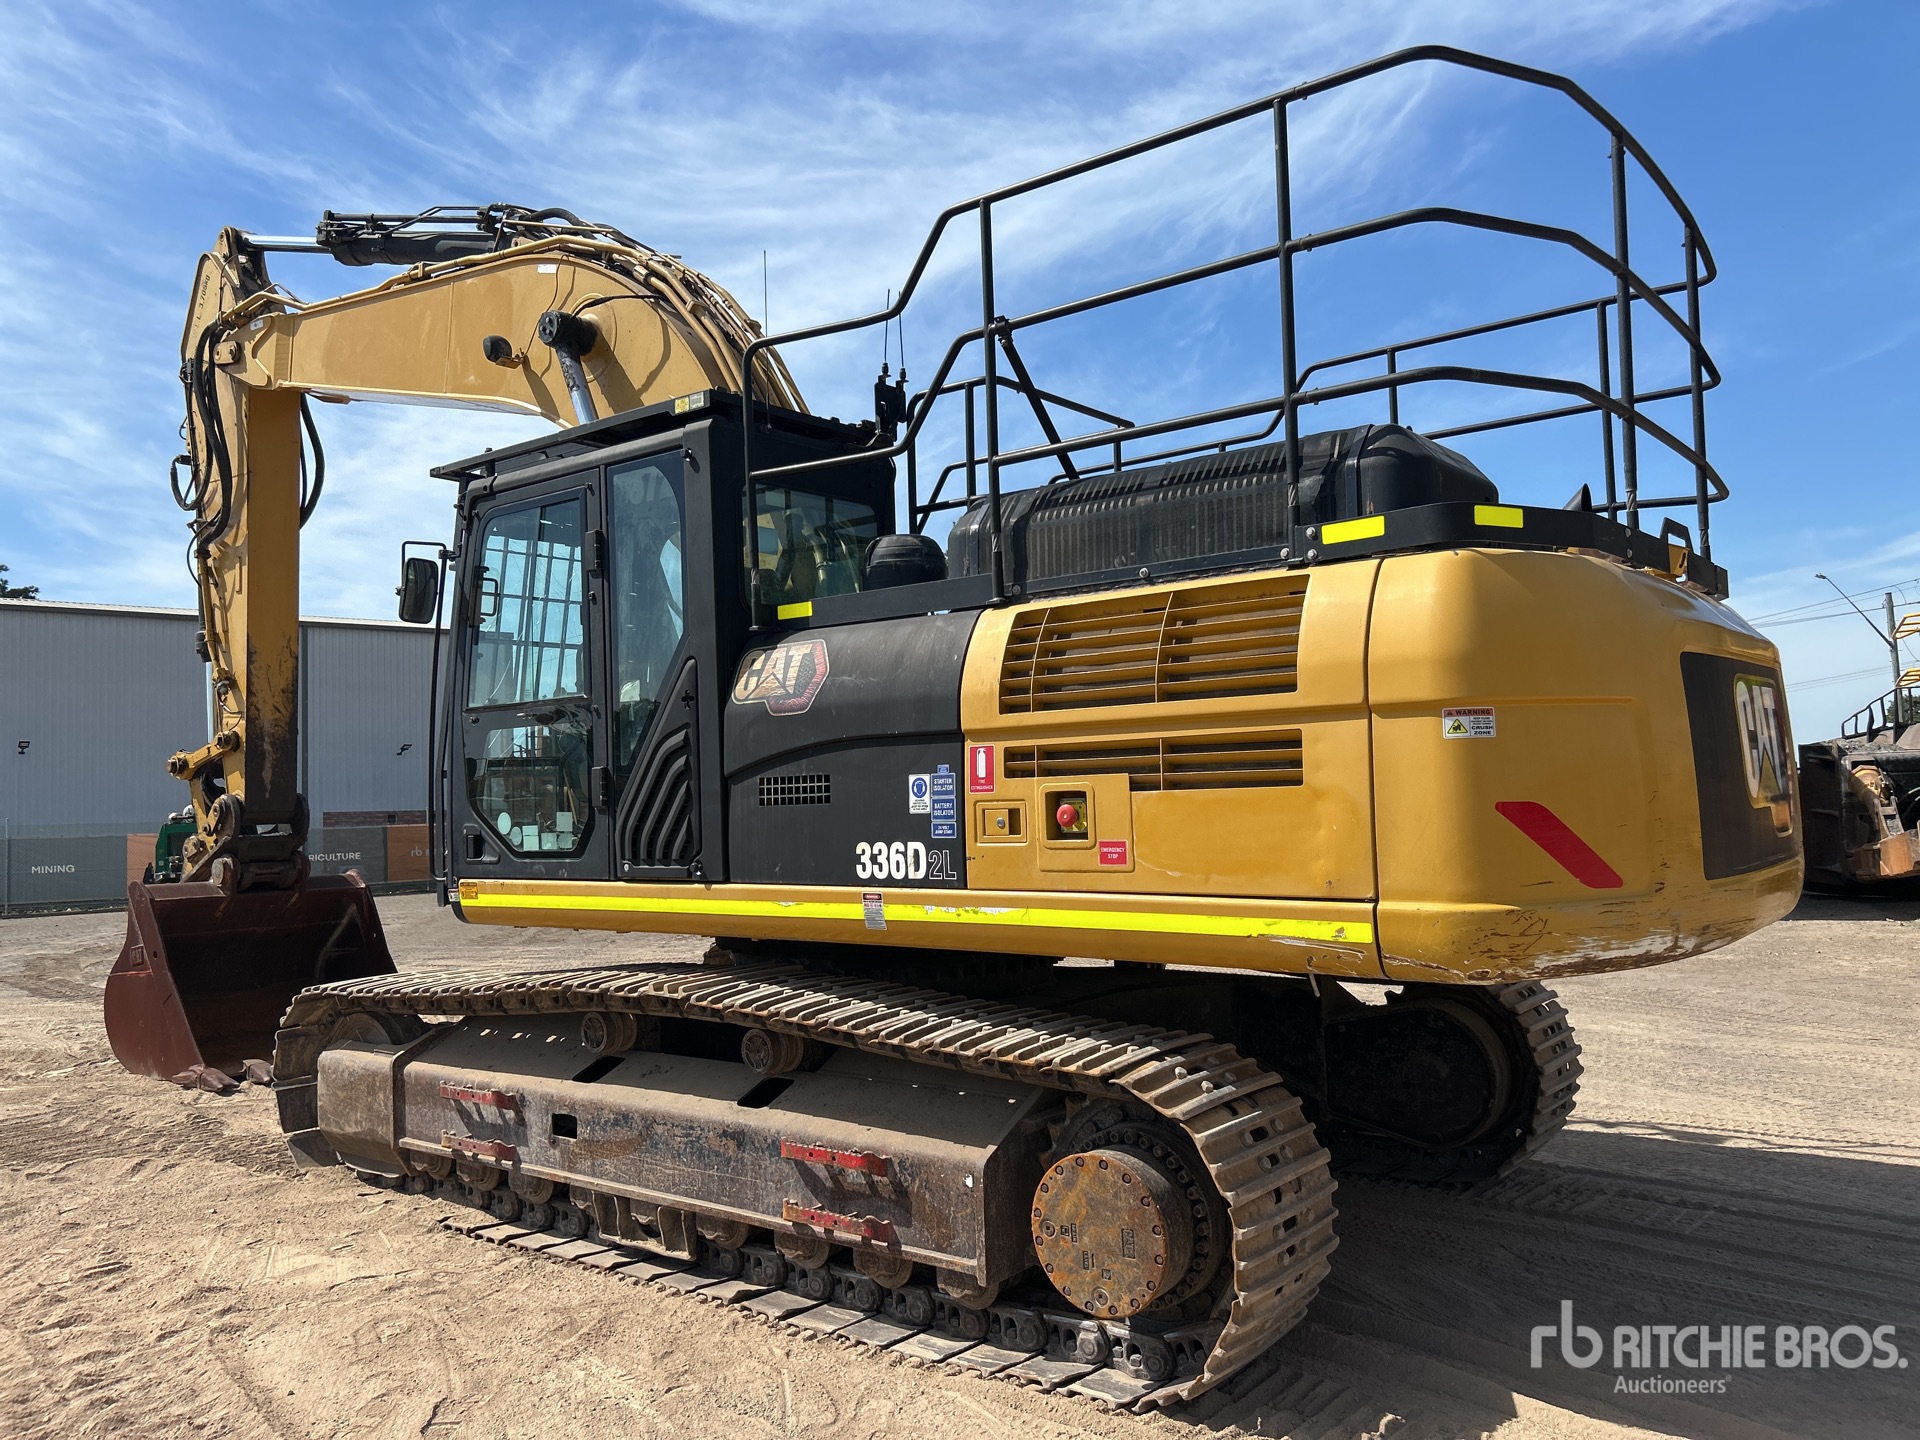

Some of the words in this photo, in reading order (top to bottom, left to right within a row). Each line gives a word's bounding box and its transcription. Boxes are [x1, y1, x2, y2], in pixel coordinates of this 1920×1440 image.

[734, 643, 813, 701] CAT
[1736, 680, 1784, 798] CAT
[31, 864, 75, 874] MINING
